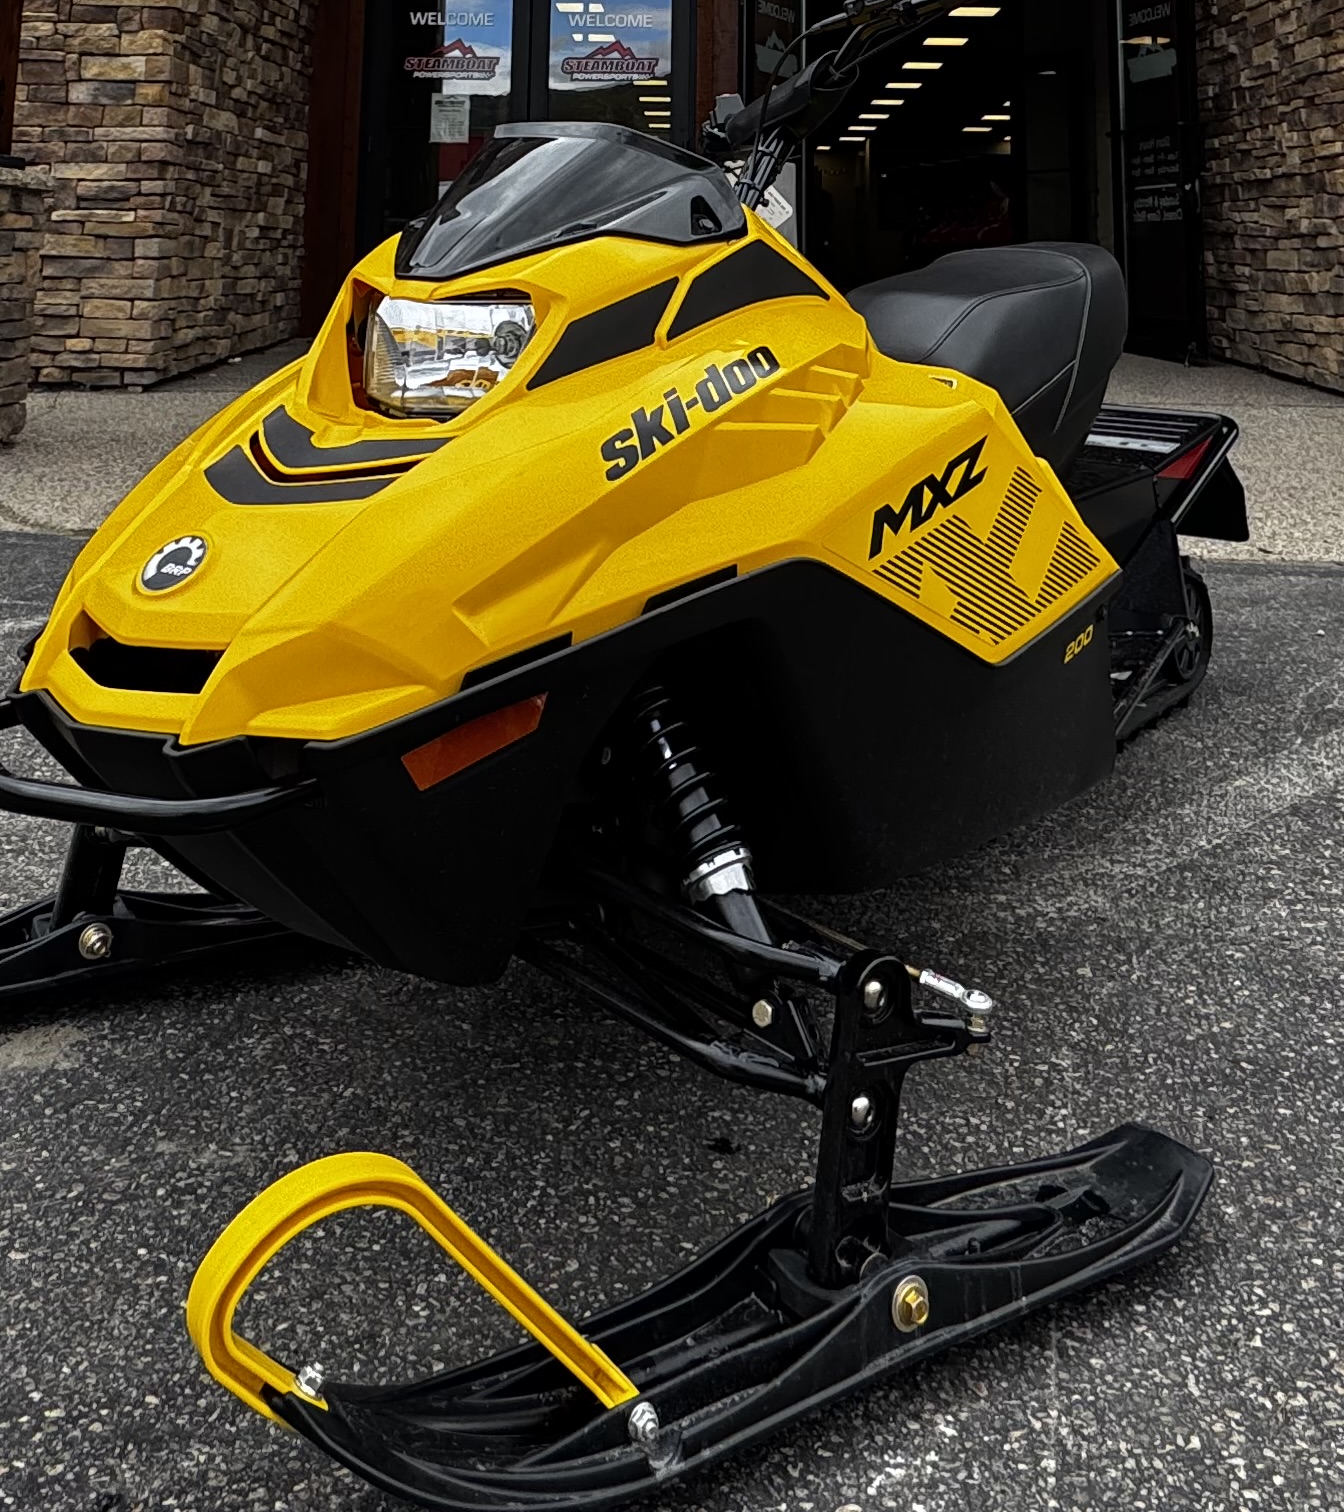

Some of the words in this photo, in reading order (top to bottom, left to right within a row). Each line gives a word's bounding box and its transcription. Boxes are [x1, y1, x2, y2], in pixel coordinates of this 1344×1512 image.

[409, 12, 494, 26] WELCOME
[568, 14, 653, 28] WELCOME
[404, 56, 500, 71] STEAMBOAT
[563, 58, 658, 73] STEAMBOAT
[413, 71, 482, 79] POWERSPORTS
[572, 73, 640, 81] POWERSPORTS
[868, 433, 989, 561] MXZ
[160, 563, 192, 576] BRP
[1063, 624, 1094, 665] 200
